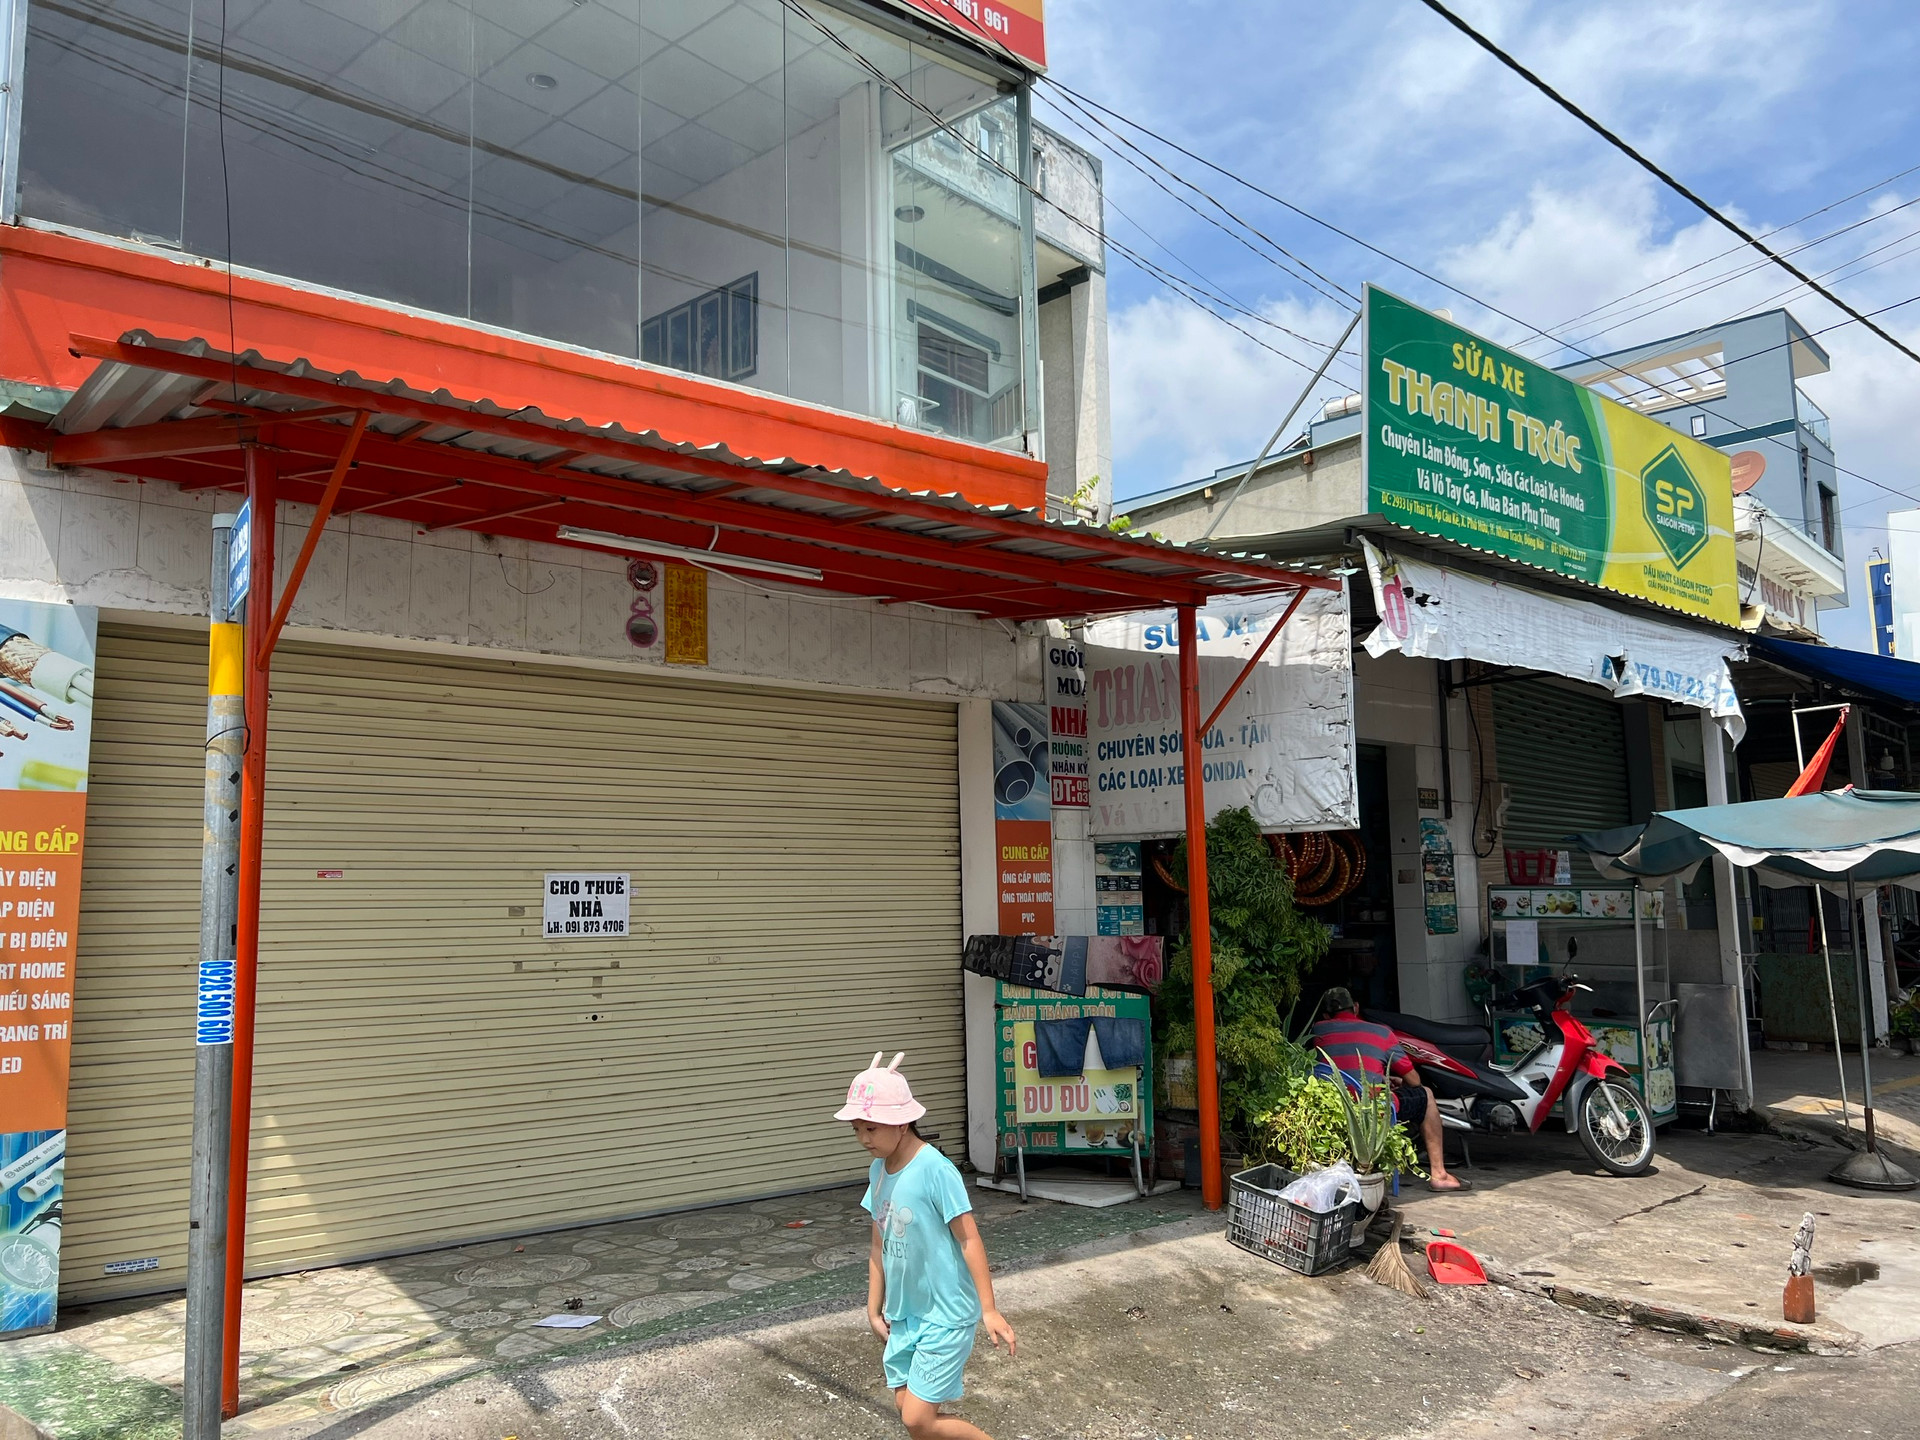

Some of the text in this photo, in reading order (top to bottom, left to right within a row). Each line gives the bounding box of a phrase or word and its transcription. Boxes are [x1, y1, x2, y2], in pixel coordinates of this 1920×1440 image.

[983, 7, 1009, 35] 961
[1452, 341, 1525, 397] SỬA XE
[1382, 358, 1581, 474] THANH TRÚC
[1381, 424, 1420, 457] Chuyên
[1422, 439, 1443, 465] Làm
[1473, 457, 1495, 484] Sơn,
[1496, 464, 1513, 488] Sửa
[1514, 470, 1529, 493] Các
[1530, 476, 1548, 503] Loại
[1549, 483, 1559, 503] Xe
[1560, 487, 1584, 512] Honda
[1392, 495, 1406, 511] 2933
[1417, 467, 1560, 536] Vá Vỏ Tay Ga, Mua Bán Phụ Tùng
[1656, 479, 1694, 517] SP
[1656, 514, 1676, 532] SAIGON
[1673, 575, 1695, 592] SAIGON
[1695, 583, 1713, 597] PETRO
[1051, 741, 1083, 758] RUỘNG
[1097, 733, 1155, 761] CHUYÊN
[1052, 760, 1075, 775] NHẬN
[1099, 767, 1127, 792] CÁC
[1130, 767, 1163, 793] LOẠI
[1167, 766, 1185, 785] XE
[1053, 779, 1076, 803] ĐT:
[1077, 792, 1088, 803] 03
[34, 825, 79, 852] CẤP
[1002, 842, 1050, 860] CUNG CẤP
[18, 867, 57, 890] ĐIỆN
[550, 880, 580, 895] CHO
[584, 876, 625, 895] THUÊ
[1002, 869, 1017, 884] ỐNG
[1033, 871, 1051, 884] NƯỚC
[569, 896, 603, 917] NHÀ
[1002, 889, 1053, 903] ỐNG THOÁT NƯỚC
[17, 898, 55, 921] ĐIỆN
[1021, 912, 1036, 923] PVC
[547, 920, 624, 933] LH: 091 873 4706
[10, 932, 26, 952] BỊ
[30, 929, 68, 951] ĐIỆN
[20, 962, 66, 979] HOME
[31, 990, 71, 1010] SÁNG
[43, 1020, 68, 1040] TRÍ
[1024, 1085, 1053, 1114] ĐU
[1060, 1075, 1090, 1113] ĐỦ
[1032, 1131, 1058, 1147] ME
